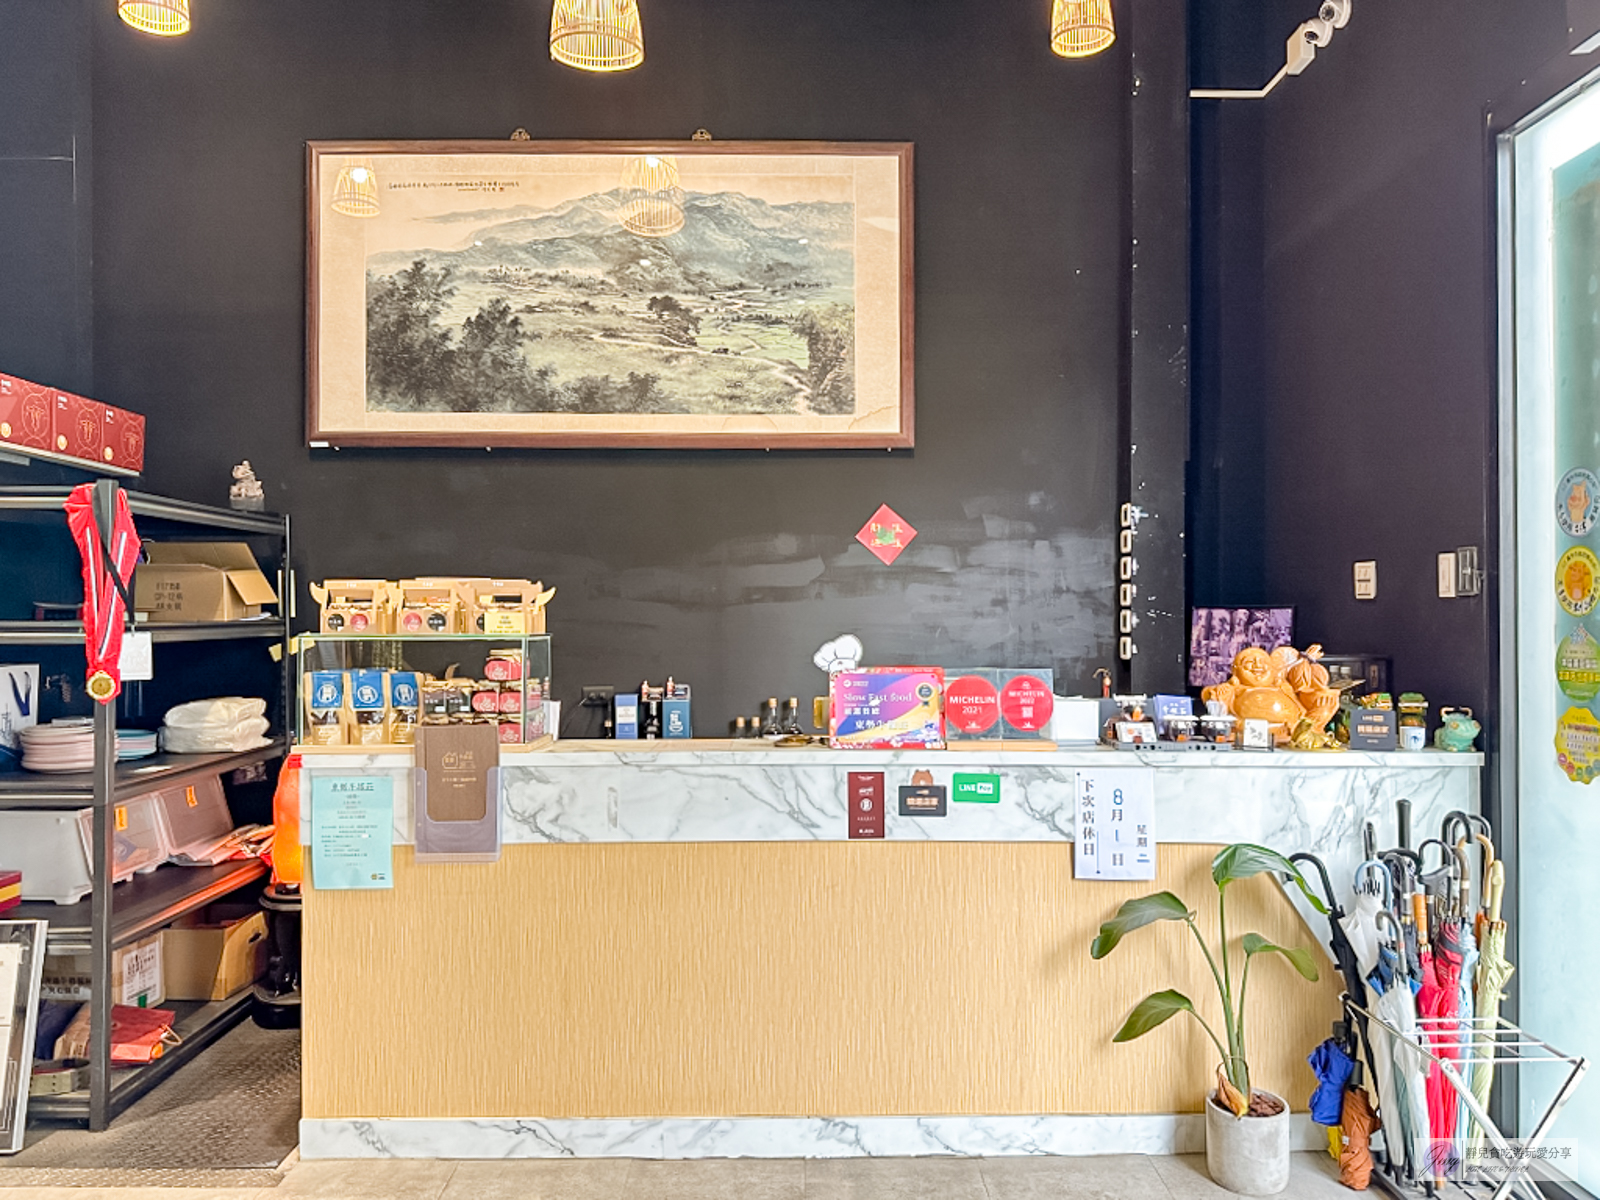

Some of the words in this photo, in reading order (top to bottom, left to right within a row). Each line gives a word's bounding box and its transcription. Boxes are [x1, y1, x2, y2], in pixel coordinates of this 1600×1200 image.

[843, 692, 867, 702] Slow
[890, 692, 912, 702] food
[1008, 690, 1045, 698] MICHELIN
[949, 695, 996, 704] MICHELIN
[962, 705, 982, 714] 2021
[958, 784, 976, 792] LINE
[1080, 778, 1096, 856] 下次店休日
[1136, 824, 1151, 863] 星期二
